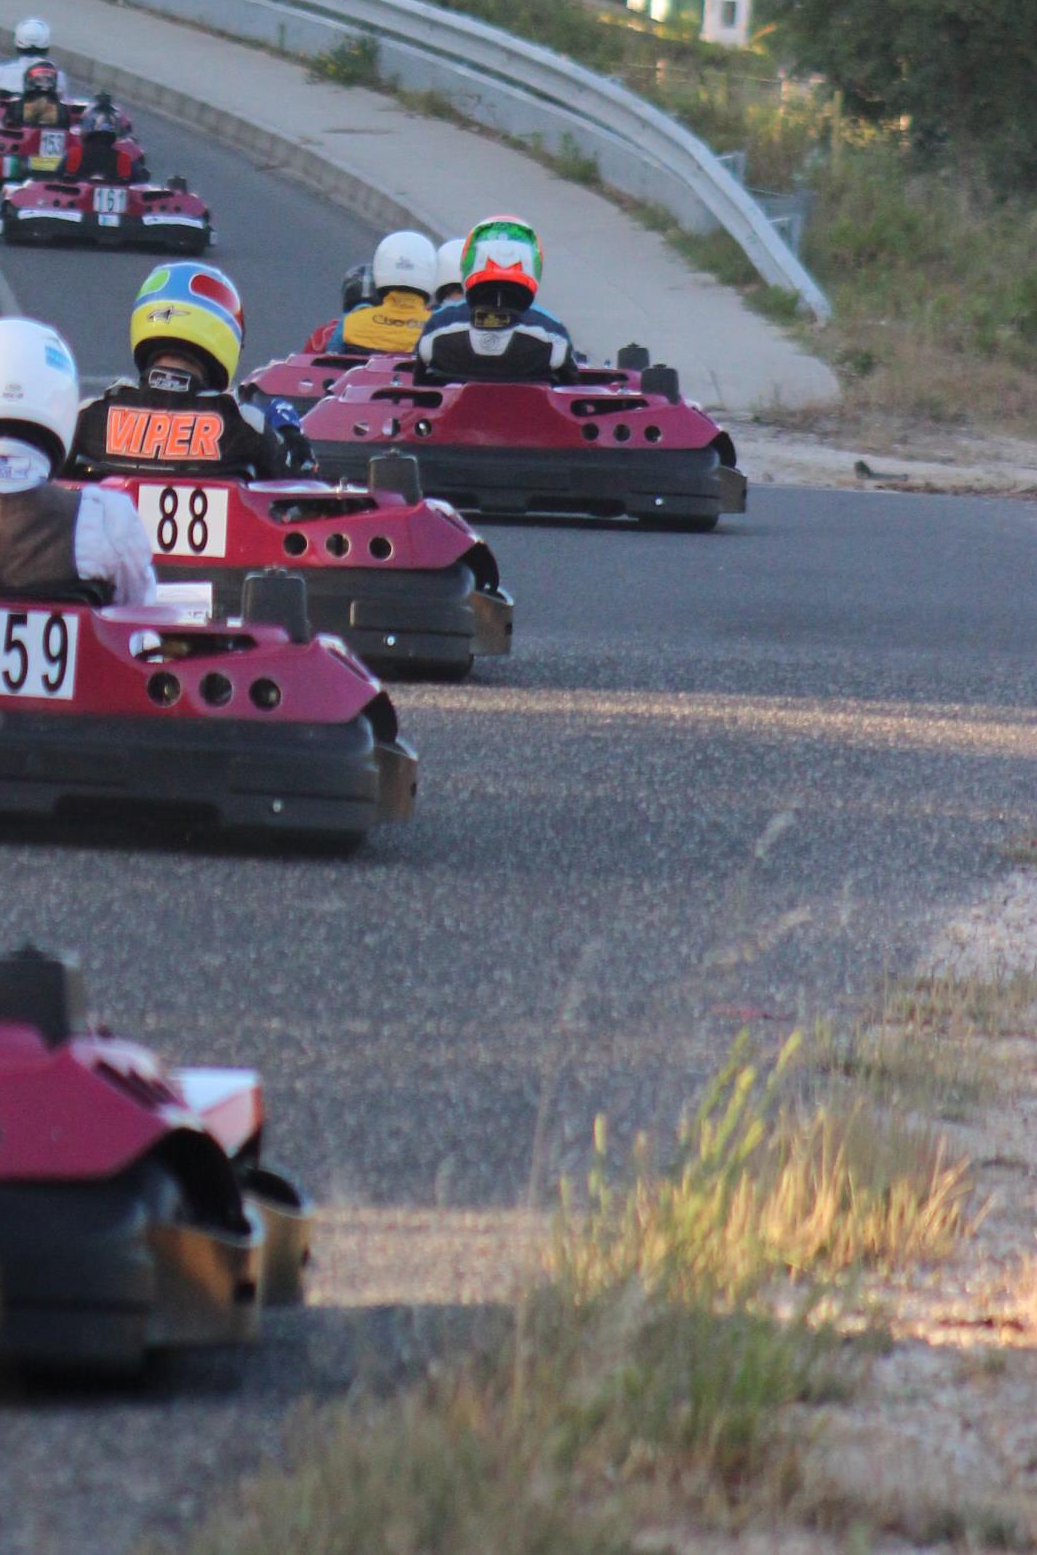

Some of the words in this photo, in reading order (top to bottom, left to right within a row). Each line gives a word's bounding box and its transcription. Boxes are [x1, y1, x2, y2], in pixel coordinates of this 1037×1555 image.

[95, 188, 126, 212] 161
[106, 407, 225, 460] VIPER
[157, 486, 209, 554] 88
